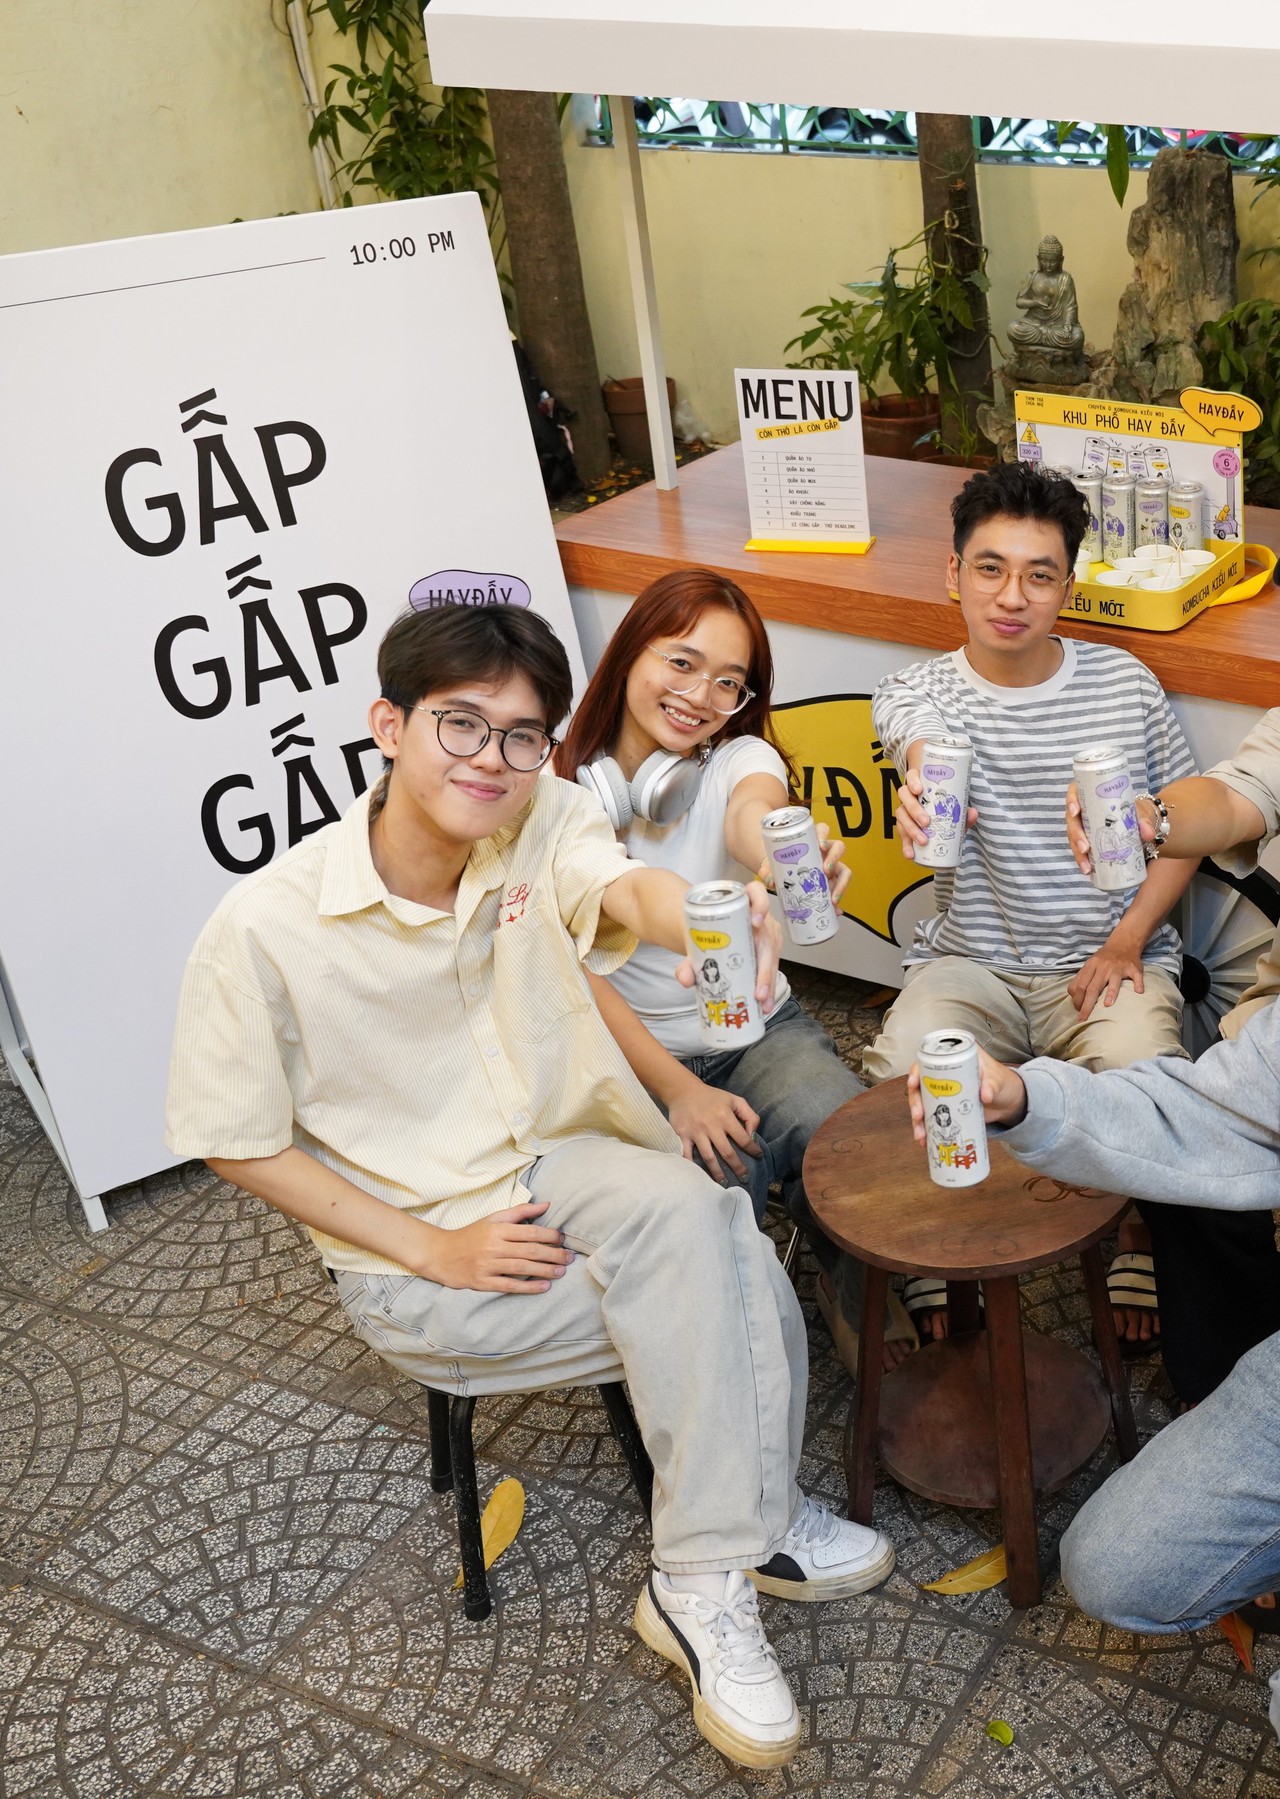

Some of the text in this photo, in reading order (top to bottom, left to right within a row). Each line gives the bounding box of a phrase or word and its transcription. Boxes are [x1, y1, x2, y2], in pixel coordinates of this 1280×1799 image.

[349, 231, 456, 266] 10:00 PM
[740, 378, 854, 422] MENU
[1199, 402, 1245, 422] HAYĐẤY
[759, 430, 773, 439] CÒN
[794, 425, 803, 435] LÀ
[807, 423, 821, 434] CÒN
[824, 420, 838, 431] GẤP
[1063, 410, 1185, 437] KHU PHỐ HAY ĐẤY
[104, 388, 328, 558] GẤP
[1223, 458, 1230, 467] 6
[1099, 599, 1125, 618] MỚI
[1182, 584, 1209, 616] KOMBUCHA
[153, 555, 368, 721] GẤP
